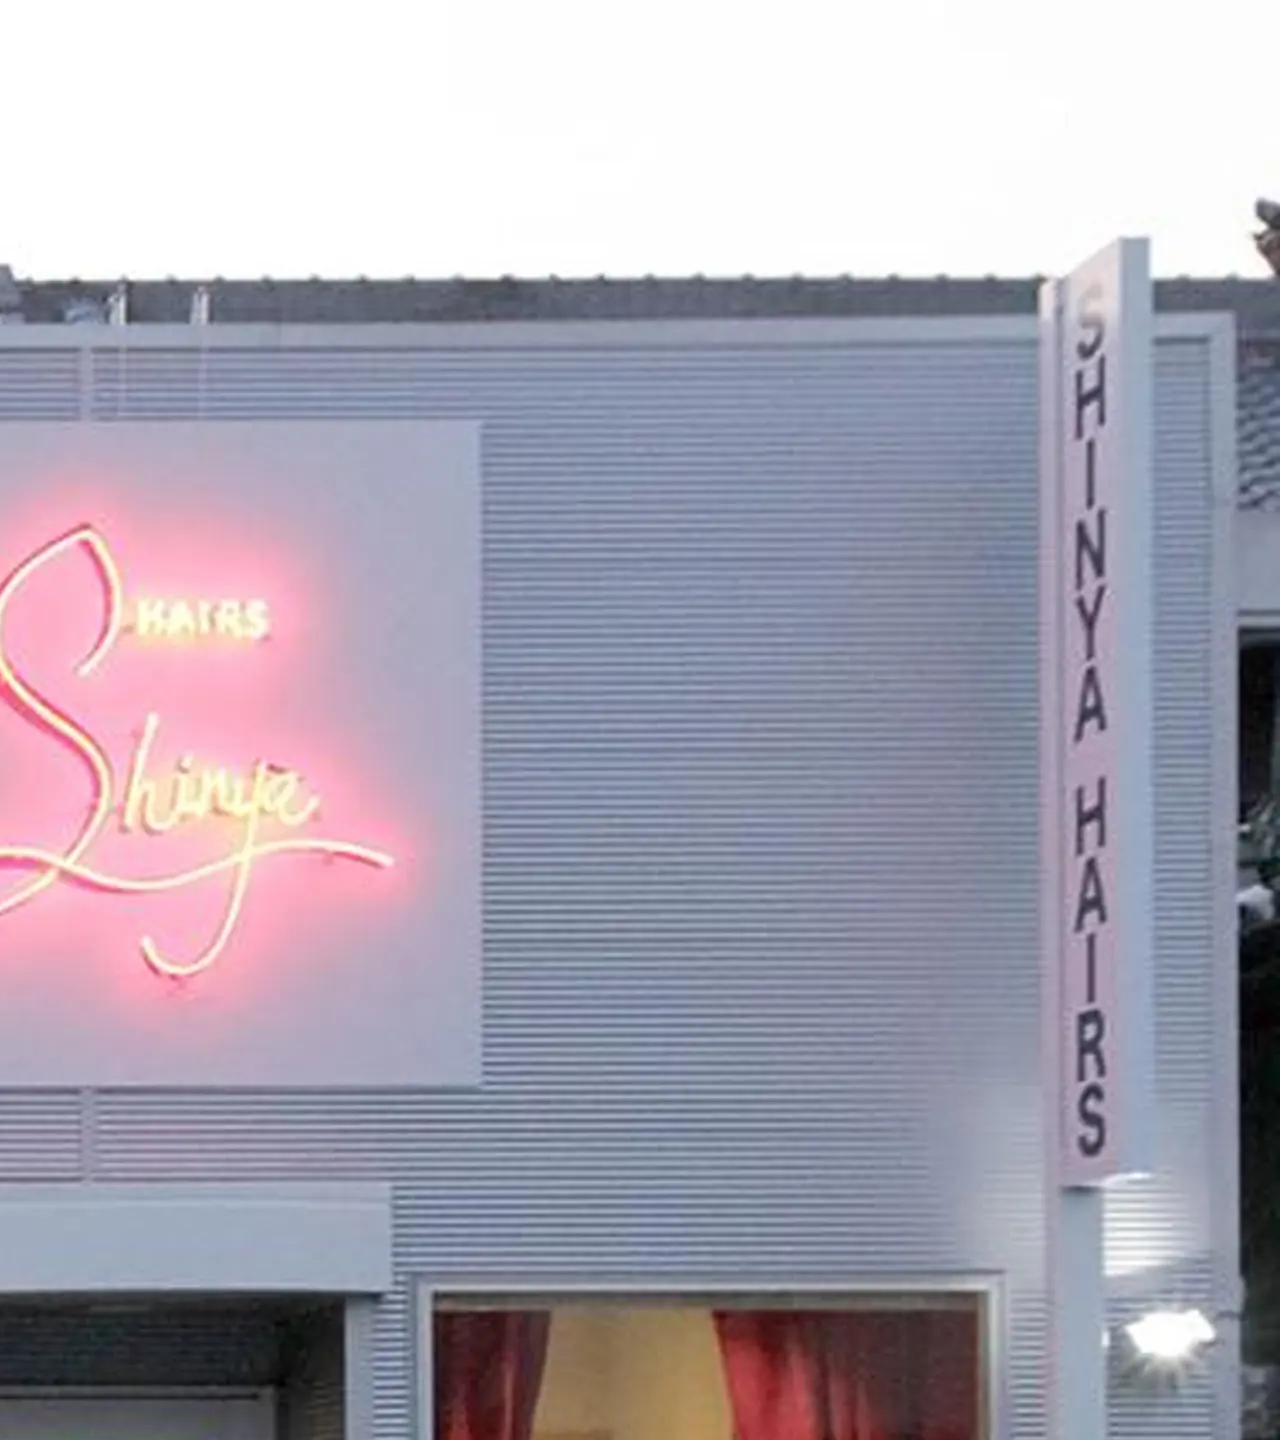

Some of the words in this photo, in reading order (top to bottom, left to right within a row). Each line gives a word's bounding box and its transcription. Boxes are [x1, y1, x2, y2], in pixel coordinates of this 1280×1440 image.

[136, 598, 269, 641] HAIRS
[1073, 284, 1107, 742] SHINYA
[1073, 776, 1107, 1157] HAIRS
